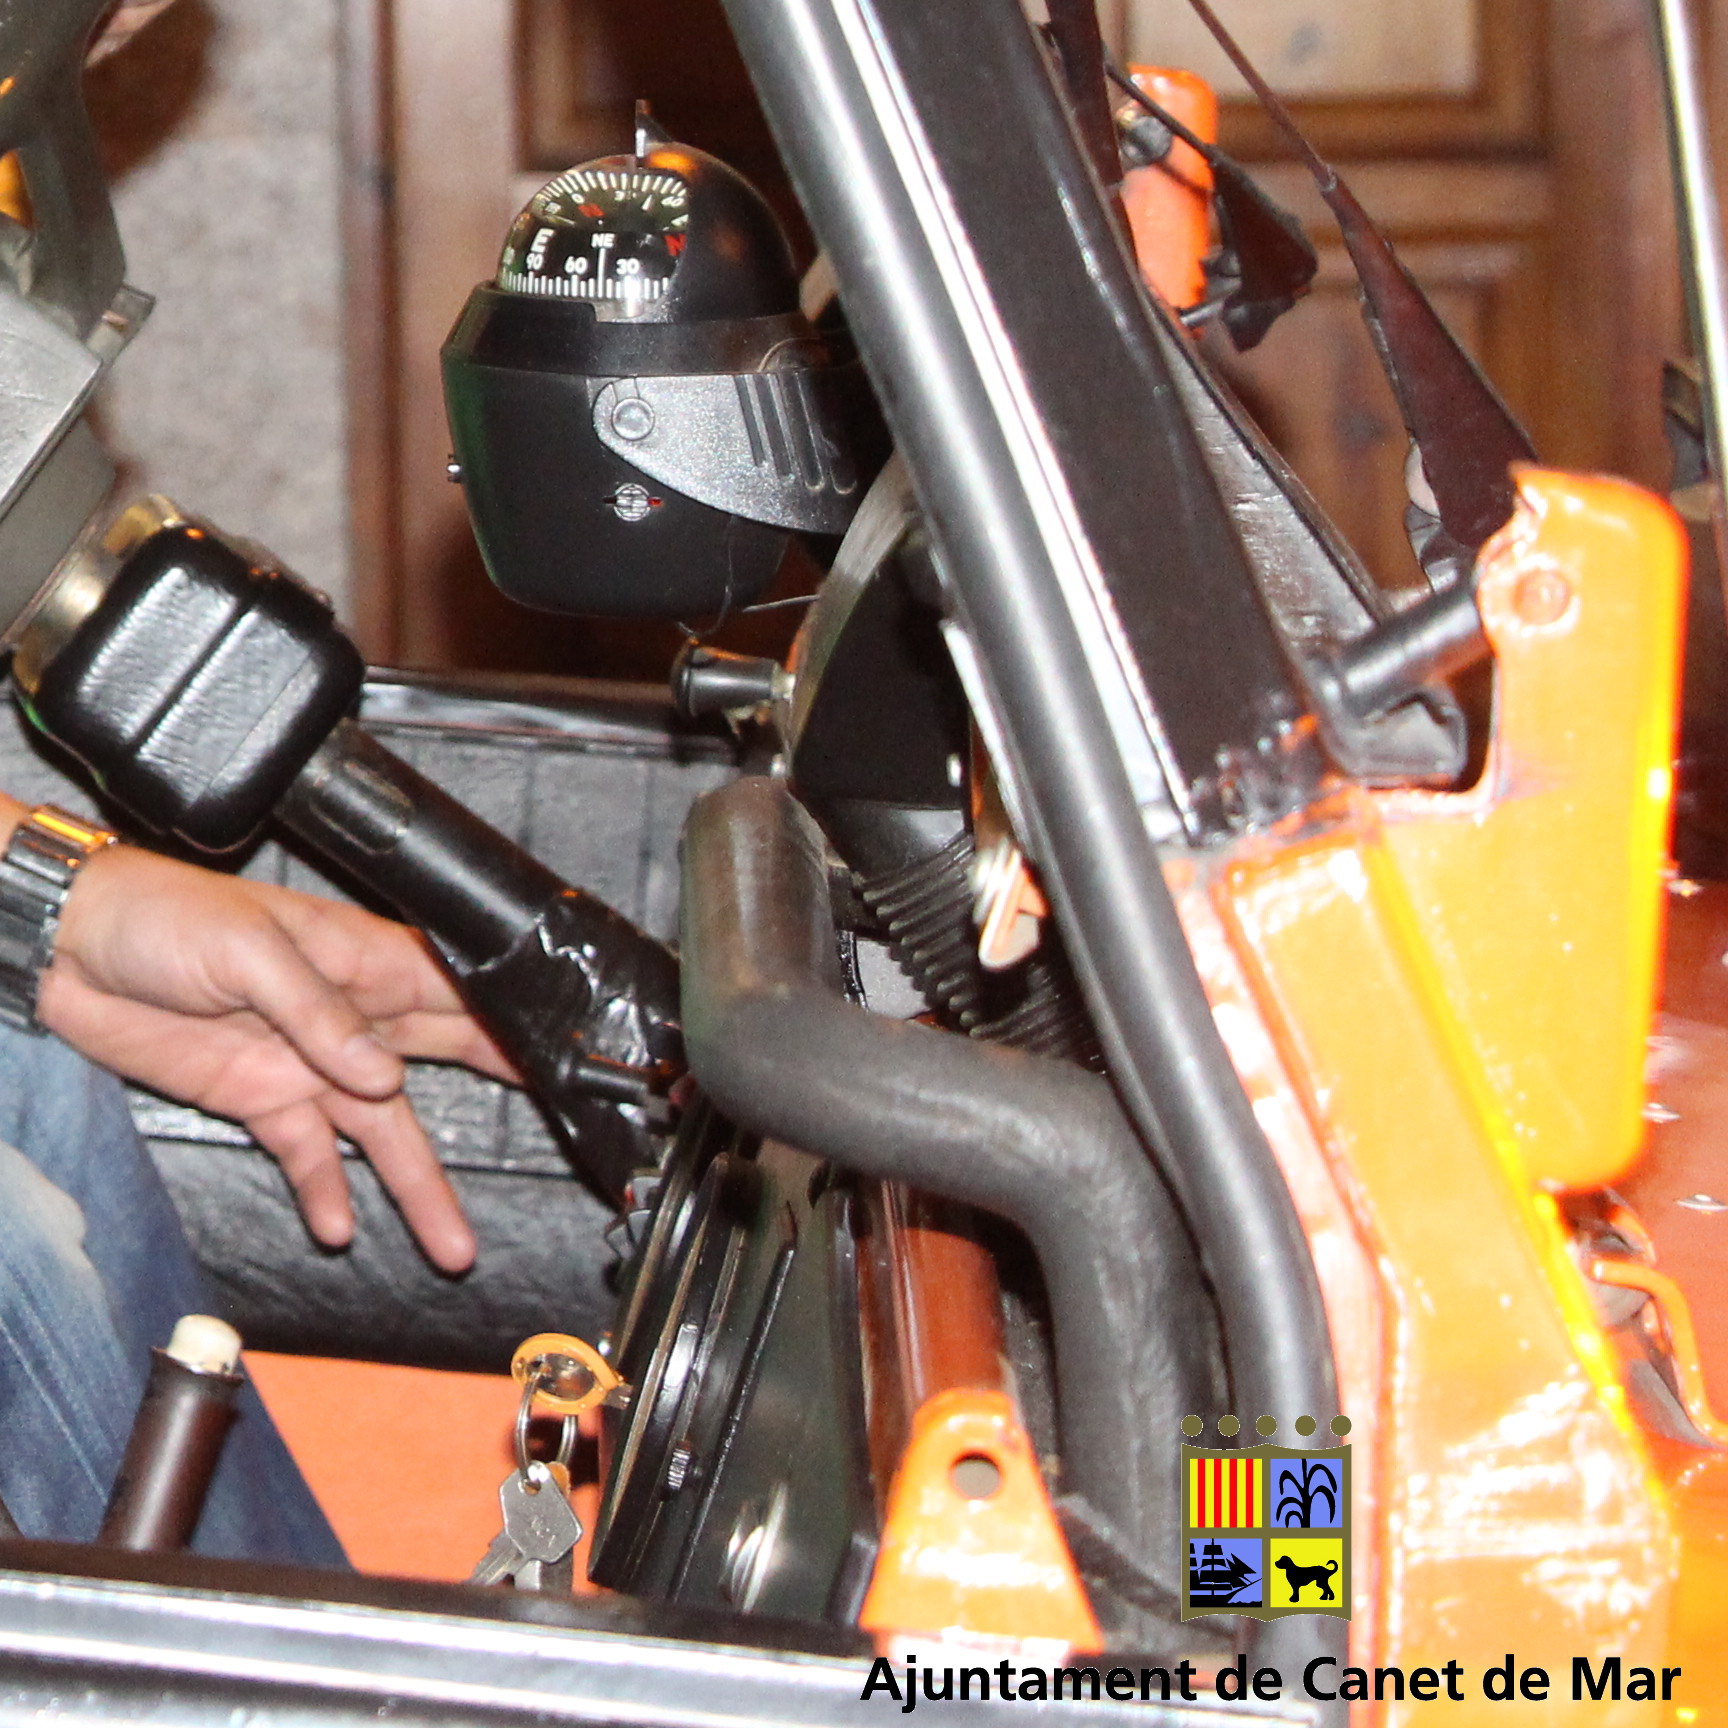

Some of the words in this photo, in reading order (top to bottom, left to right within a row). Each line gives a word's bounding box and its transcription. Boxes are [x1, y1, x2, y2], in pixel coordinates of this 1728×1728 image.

[530, 227, 555, 253] E
[591, 233, 616, 248] NE
[664, 233, 688, 257] N
[526, 253, 544, 270] 90
[565, 256, 589, 275] 60
[616, 258, 641, 274] 30
